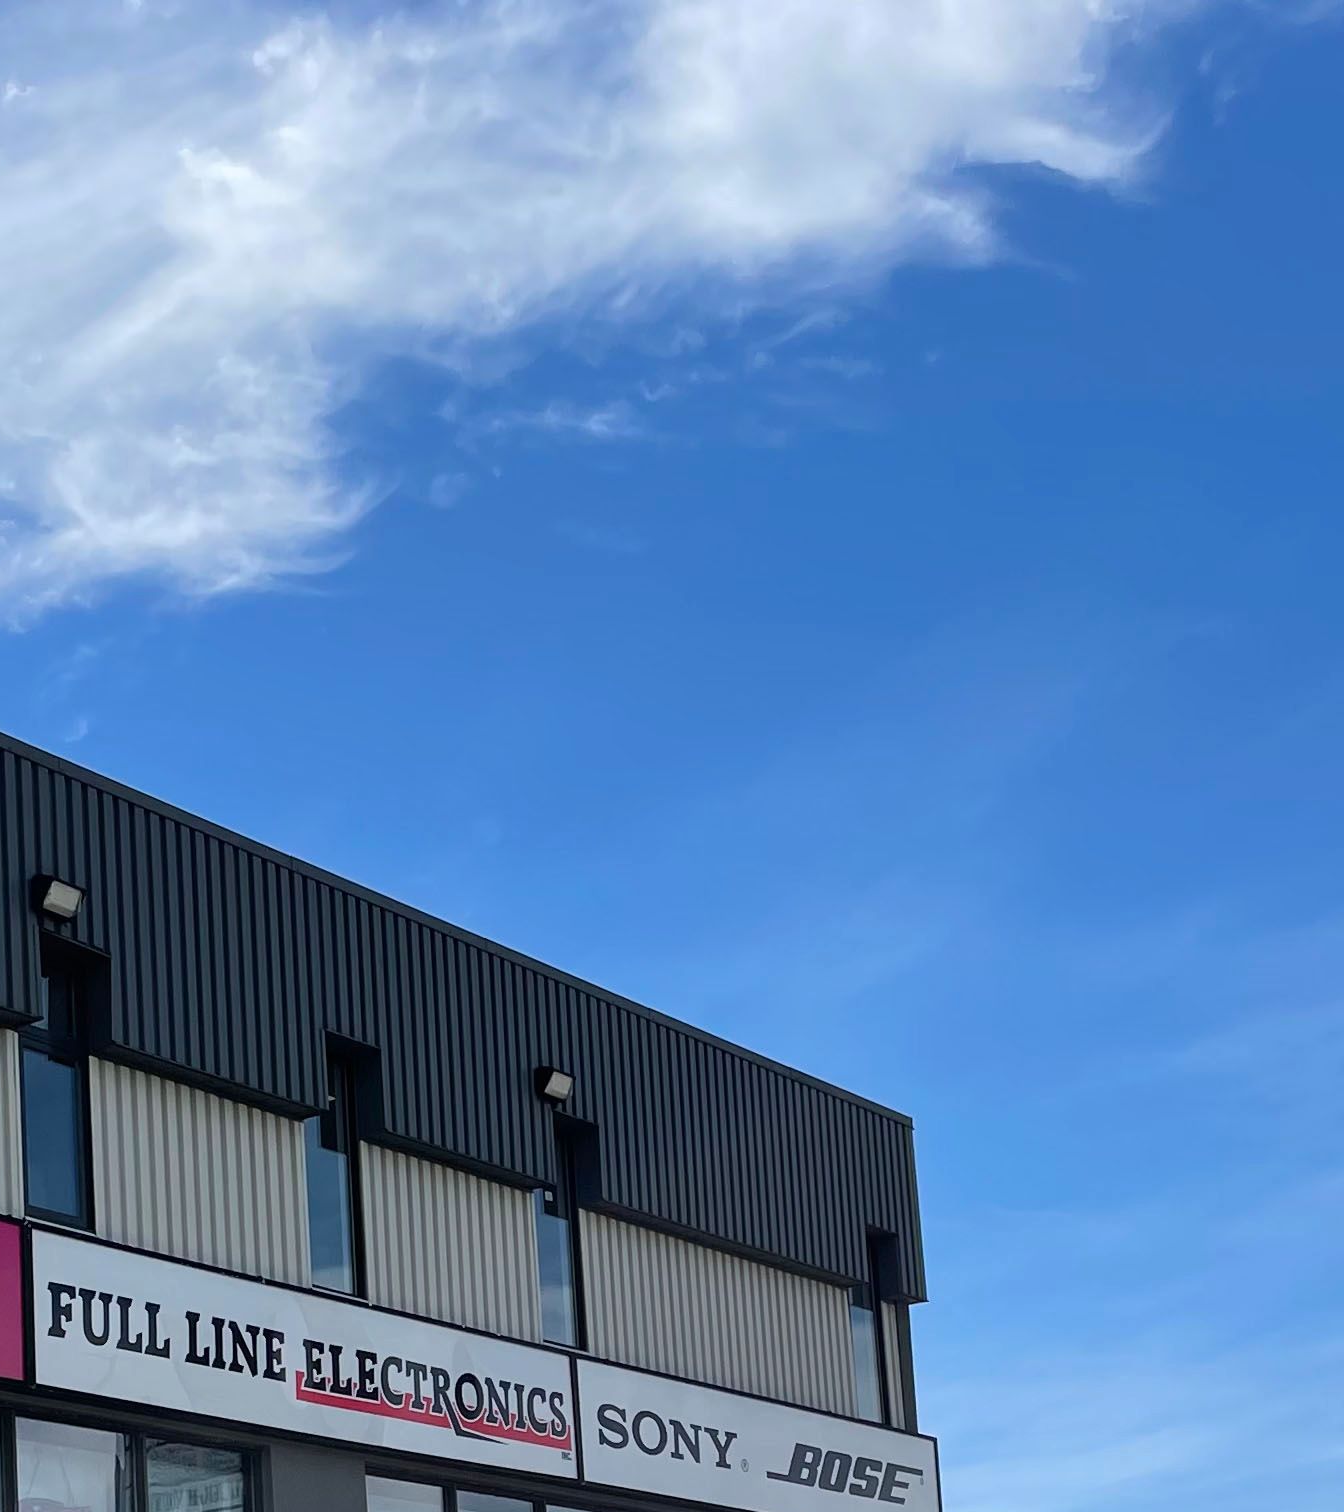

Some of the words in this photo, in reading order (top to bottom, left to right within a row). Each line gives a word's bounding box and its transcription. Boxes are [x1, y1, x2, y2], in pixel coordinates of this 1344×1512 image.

[47, 1282, 171, 1356] FULL
[184, 1310, 288, 1382] LINE
[302, 1338, 570, 1446] ELECTRONICS
[598, 1404, 738, 1470] SONY
[766, 1442, 924, 1505] BOSE
